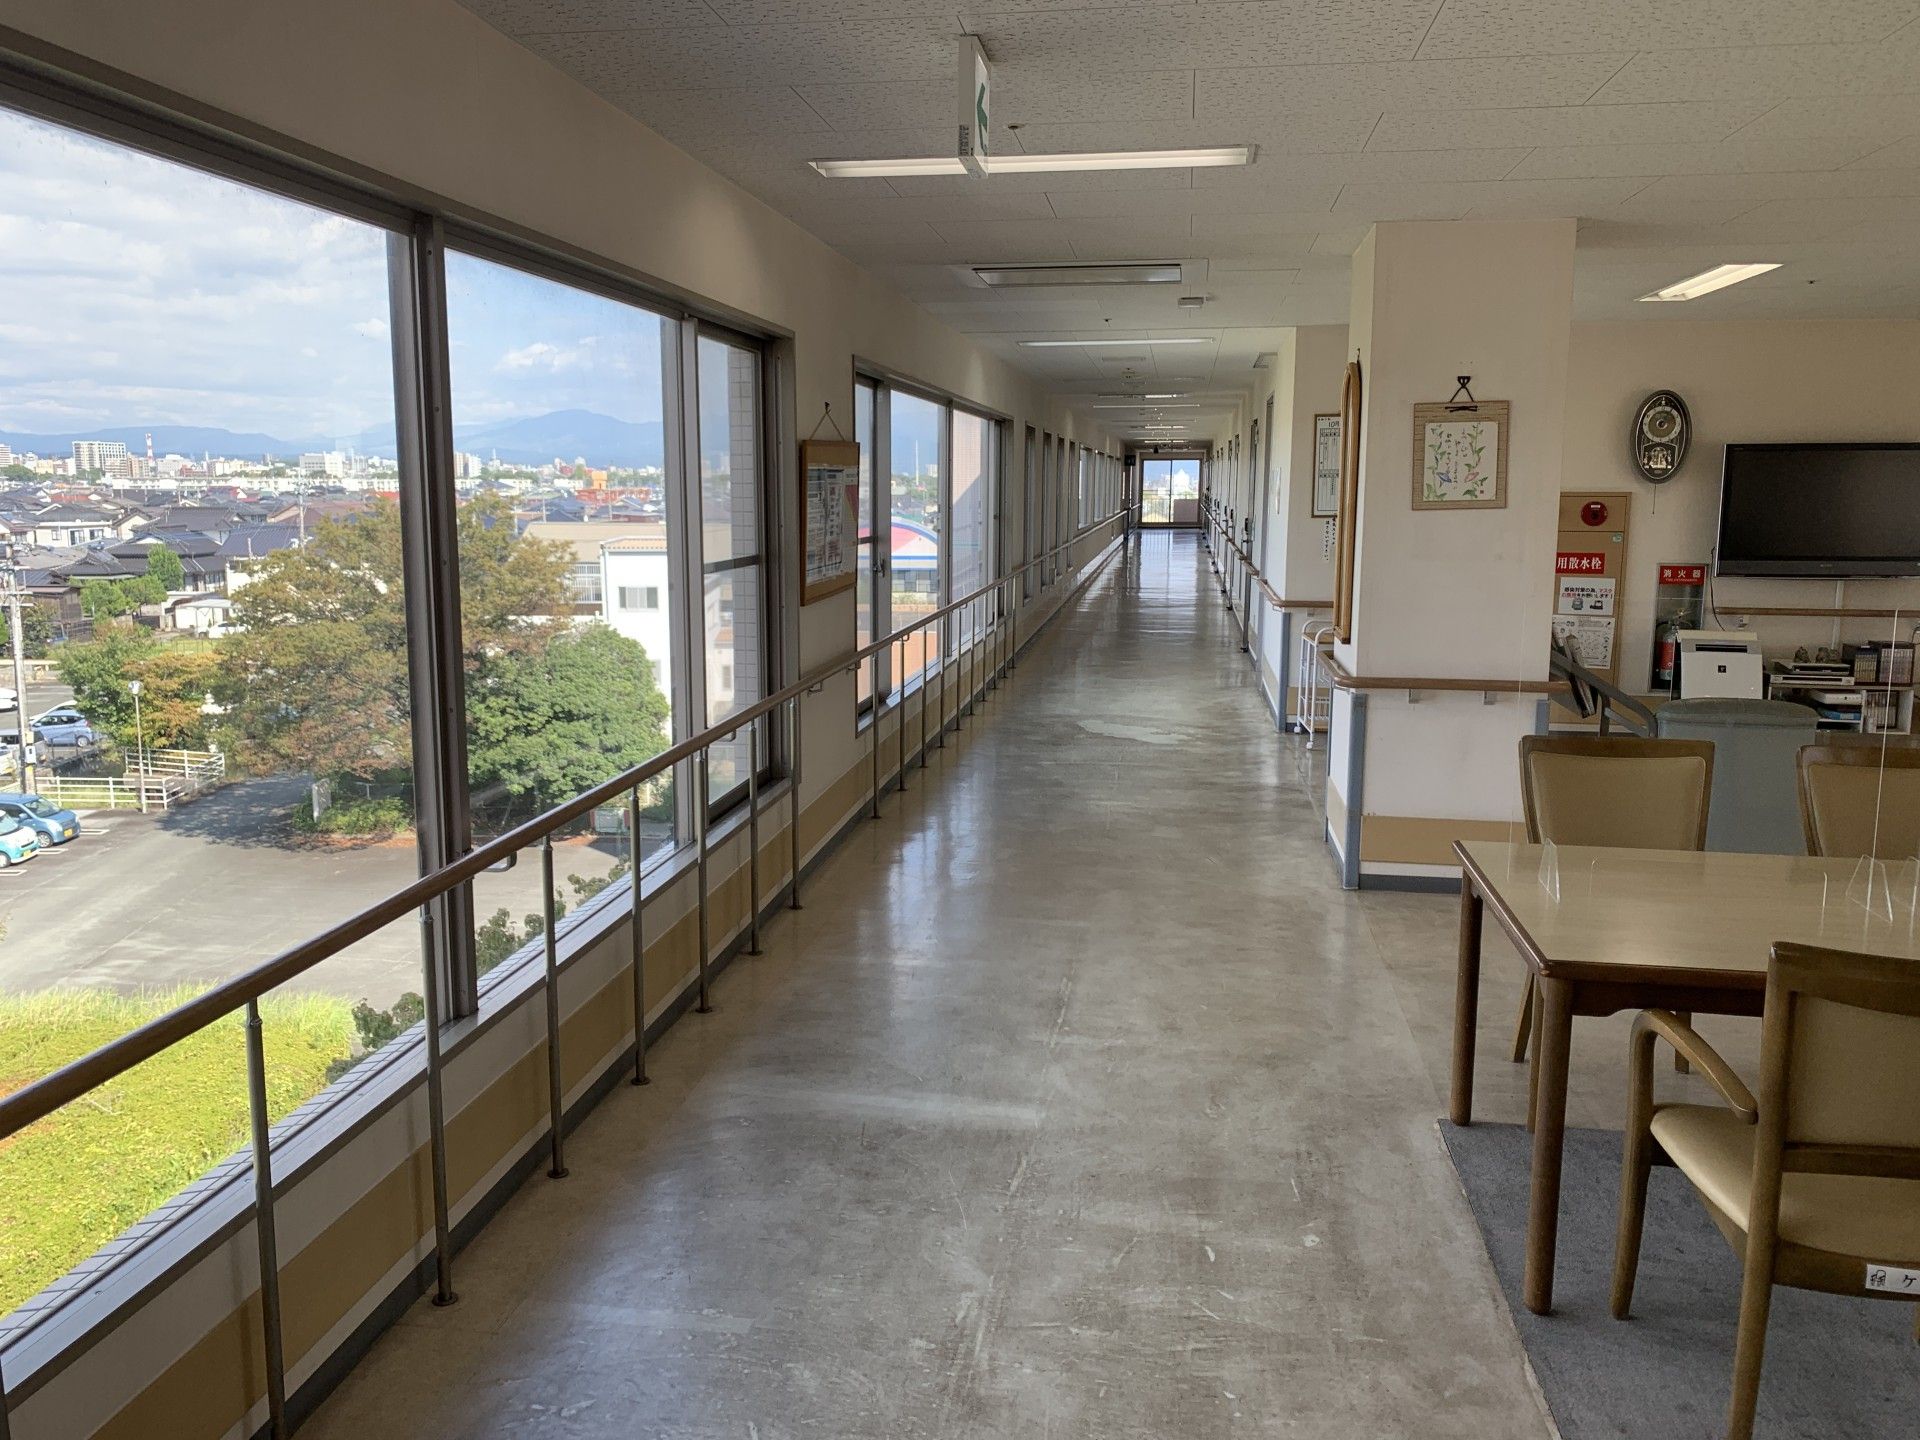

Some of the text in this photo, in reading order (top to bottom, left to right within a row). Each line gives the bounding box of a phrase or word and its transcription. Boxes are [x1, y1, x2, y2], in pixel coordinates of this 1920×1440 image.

[1557, 557, 1602, 570] 用散水栓
[1663, 569, 1701, 578] 消火器
